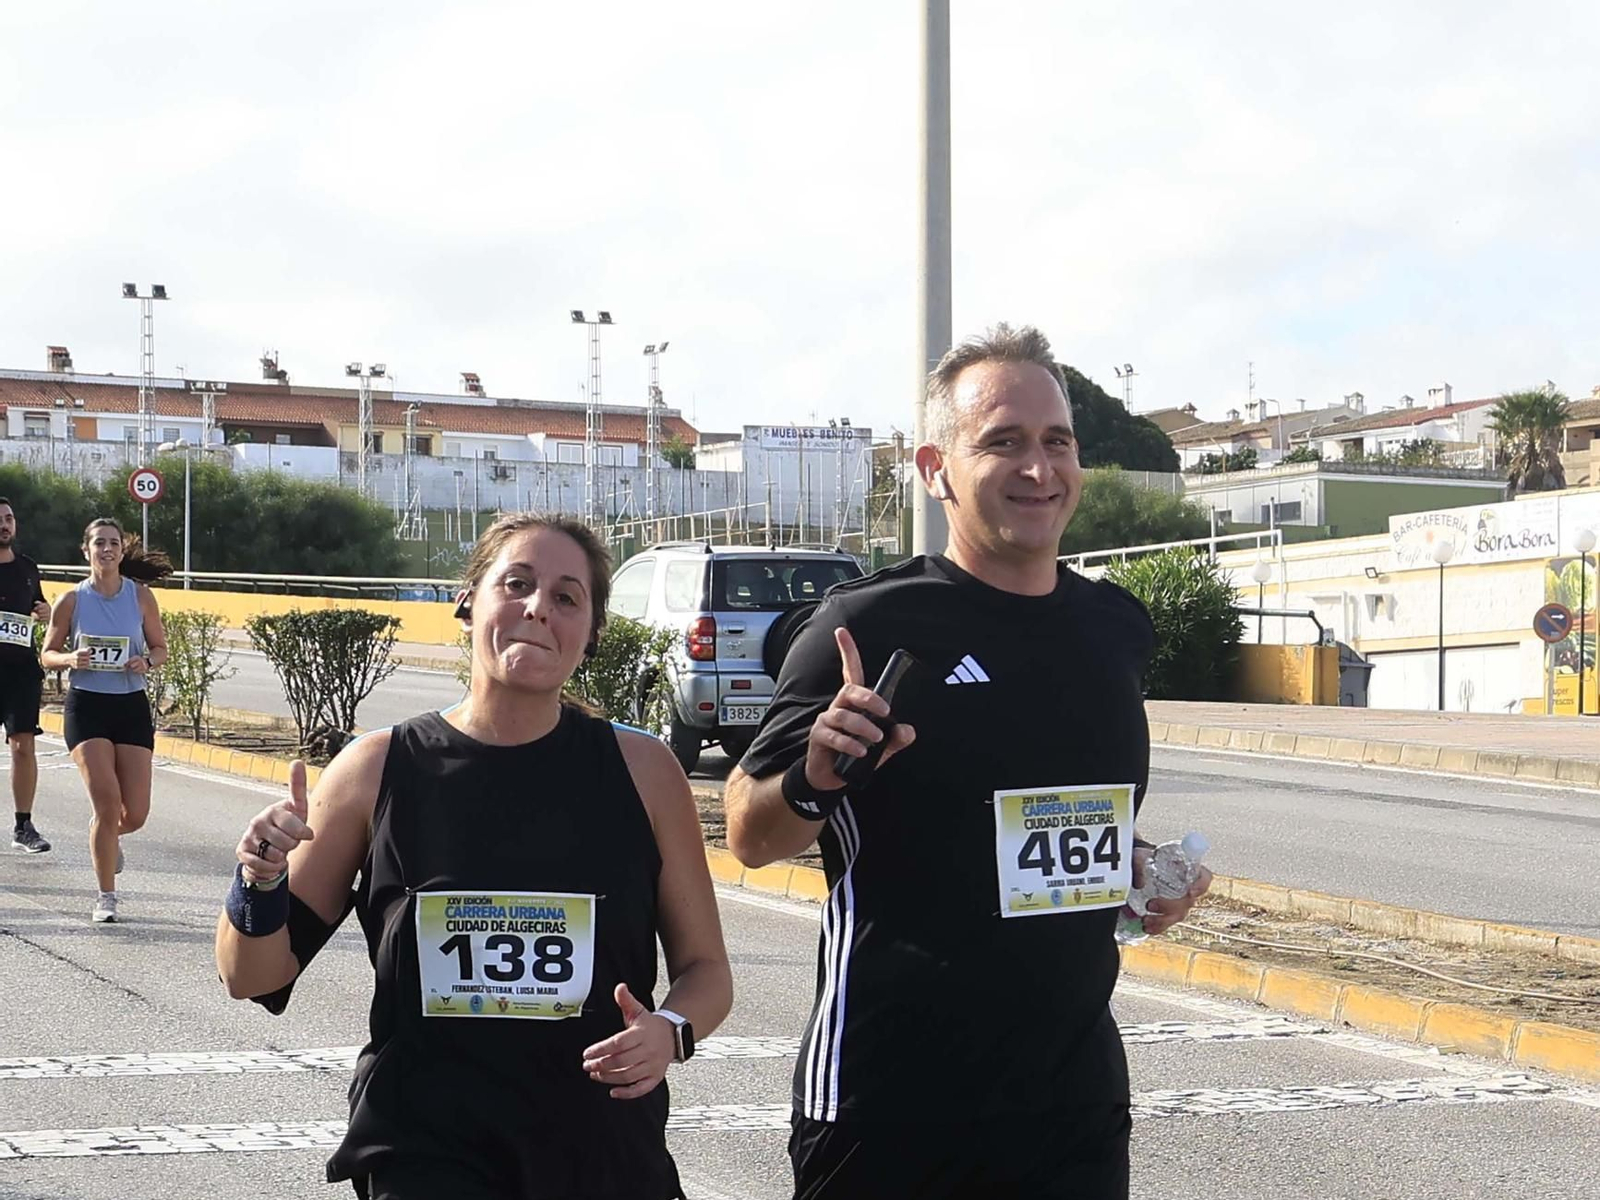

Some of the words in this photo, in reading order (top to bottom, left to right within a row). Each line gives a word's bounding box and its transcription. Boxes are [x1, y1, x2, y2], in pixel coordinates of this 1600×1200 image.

[771, 428, 815, 439] MUEBES
[820, 429, 853, 440] BENTO
[137, 480, 157, 491] 50
[1474, 528, 1518, 553] Bora
[1518, 528, 1556, 549] Bora
[0, 621, 28, 637] 430
[1552, 687, 1570, 697] uper
[729, 707, 760, 720] 3825
[1022, 801, 1073, 817] CARRERA
[1074, 799, 1114, 814] URBANA
[1024, 816, 1060, 830] CIUDAD
[1061, 815, 1075, 828] DE
[1074, 812, 1115, 826] ALGECIRAS
[1017, 826, 1122, 877] 464
[463, 896, 493, 905] EDICIÓN
[445, 905, 507, 919] CARRERA
[509, 906, 566, 920] URBANA
[446, 920, 489, 932] CIUDAD
[491, 920, 506, 932] DE
[507, 920, 567, 934] ALGECIRAS
[438, 934, 574, 983] 138
